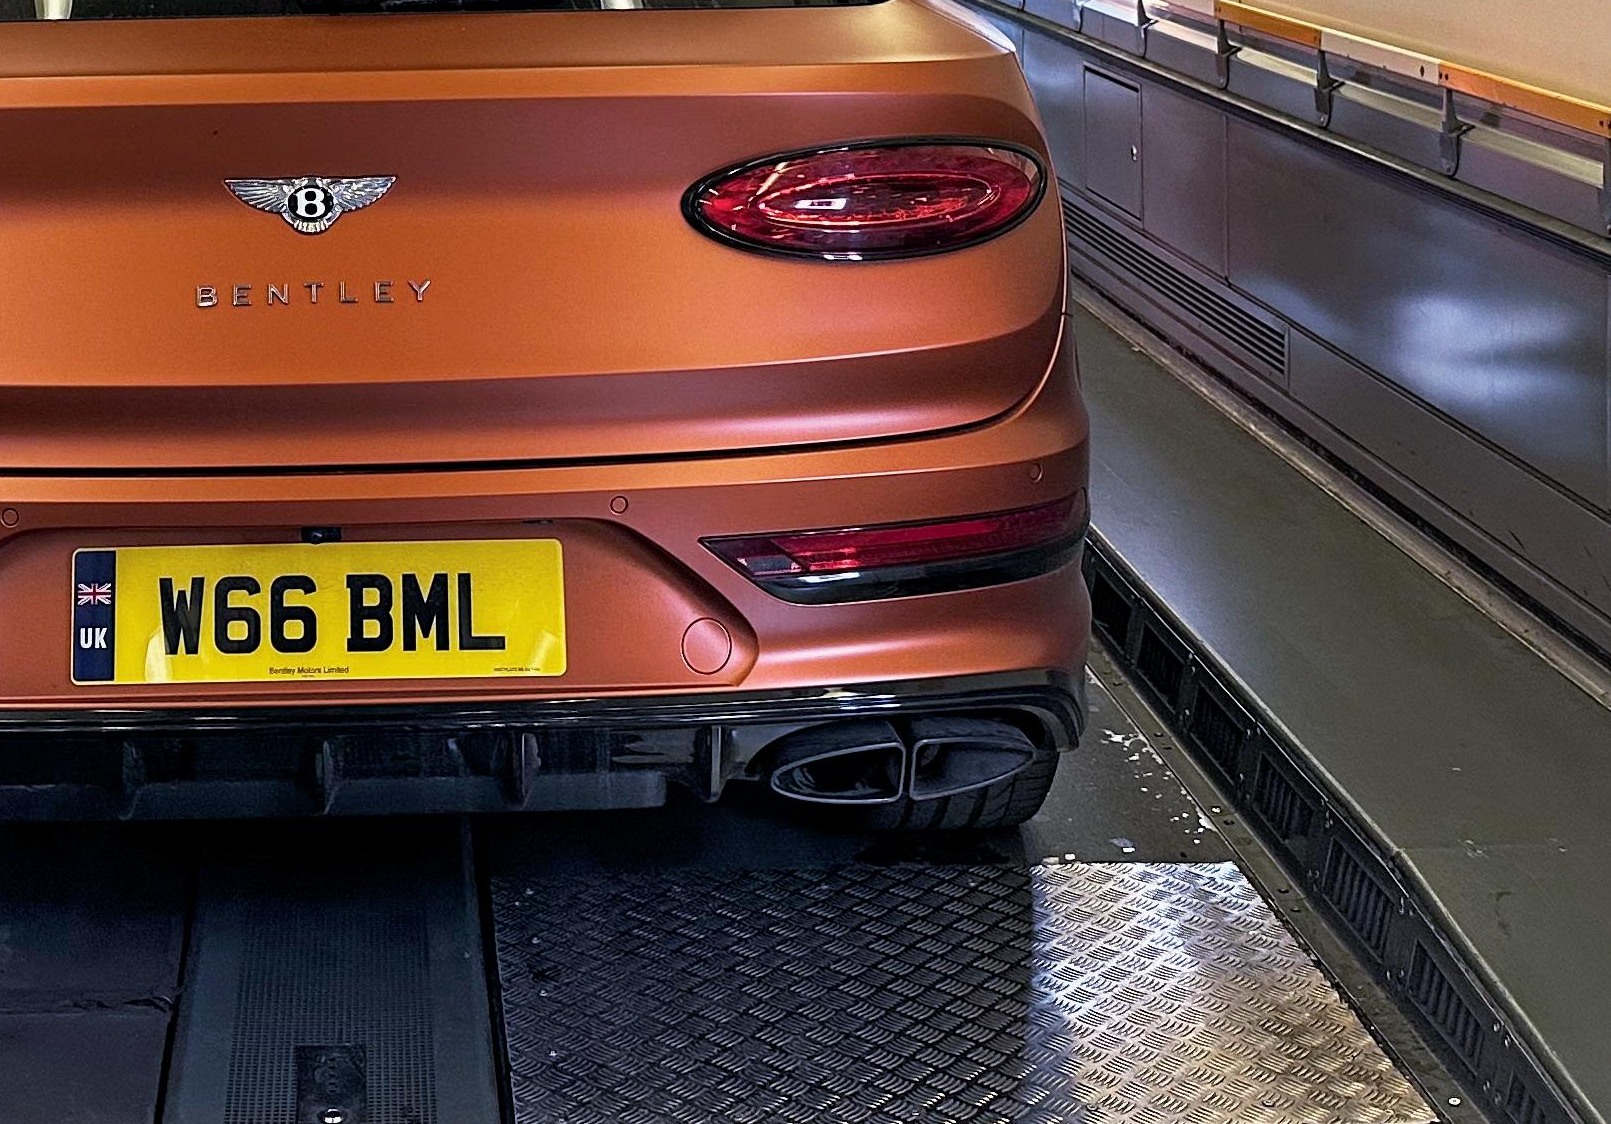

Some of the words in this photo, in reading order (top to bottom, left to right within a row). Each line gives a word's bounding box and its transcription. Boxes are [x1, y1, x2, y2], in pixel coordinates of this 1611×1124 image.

[195, 279, 432, 307] BENTLEY
[158, 575, 317, 655] W66
[345, 573, 506, 652] BML
[79, 627, 108, 649] UK
[268, 666, 296, 676] Bentley
[297, 666, 322, 674] Motors
[323, 665, 350, 674] Limited
